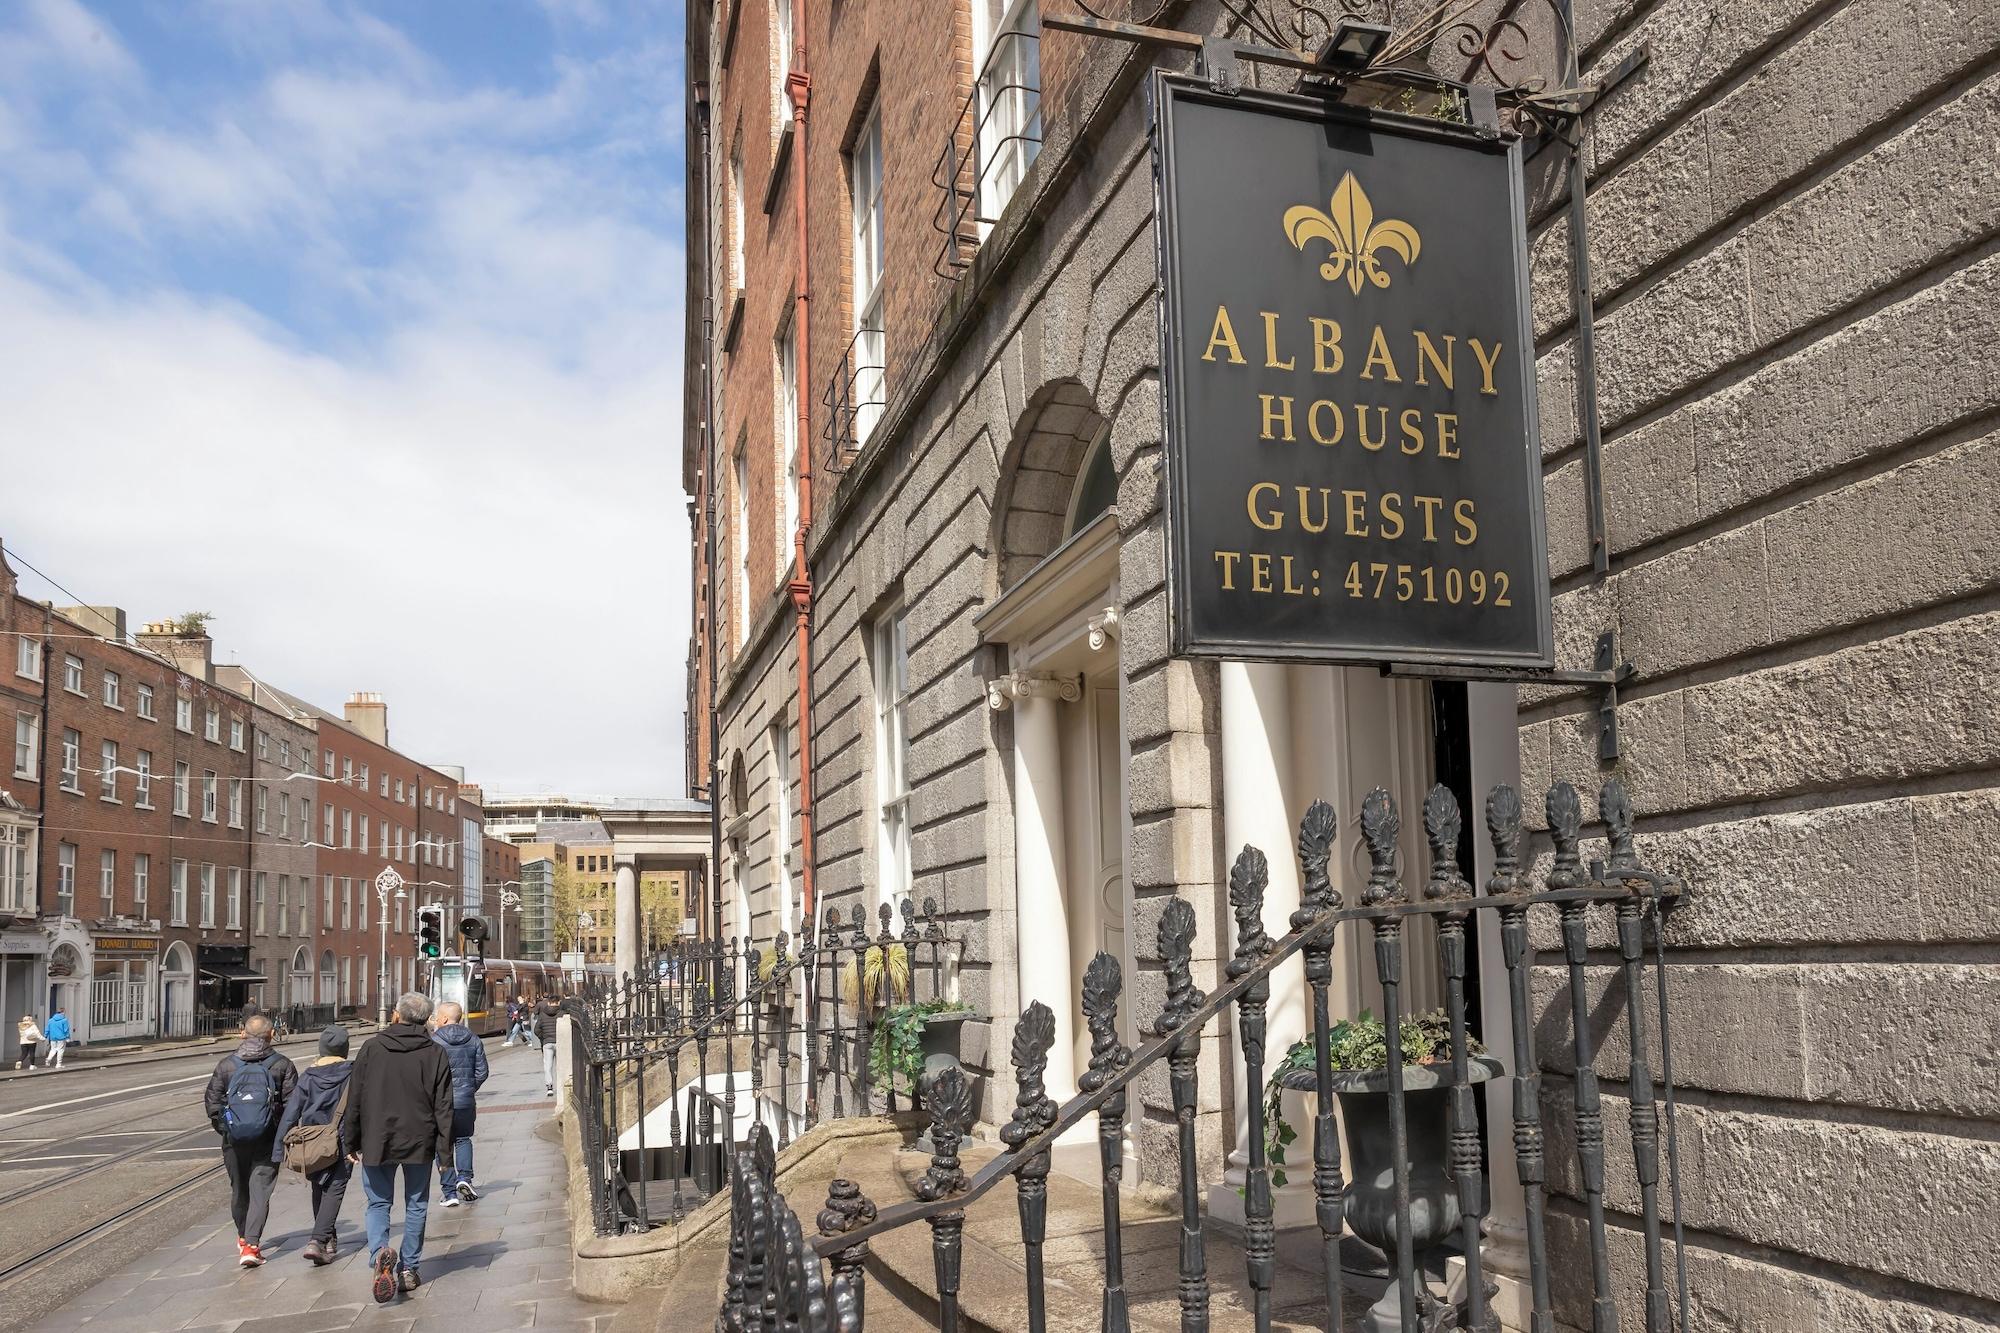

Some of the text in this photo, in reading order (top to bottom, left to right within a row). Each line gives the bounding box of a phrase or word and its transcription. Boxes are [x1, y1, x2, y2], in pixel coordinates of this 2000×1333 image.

[1201, 304, 1503, 395] ALBANY
[1258, 393, 1461, 460] HOUSE
[1246, 481, 1478, 546] GUESTS
[1214, 550, 1512, 607] TEL: 4751092
